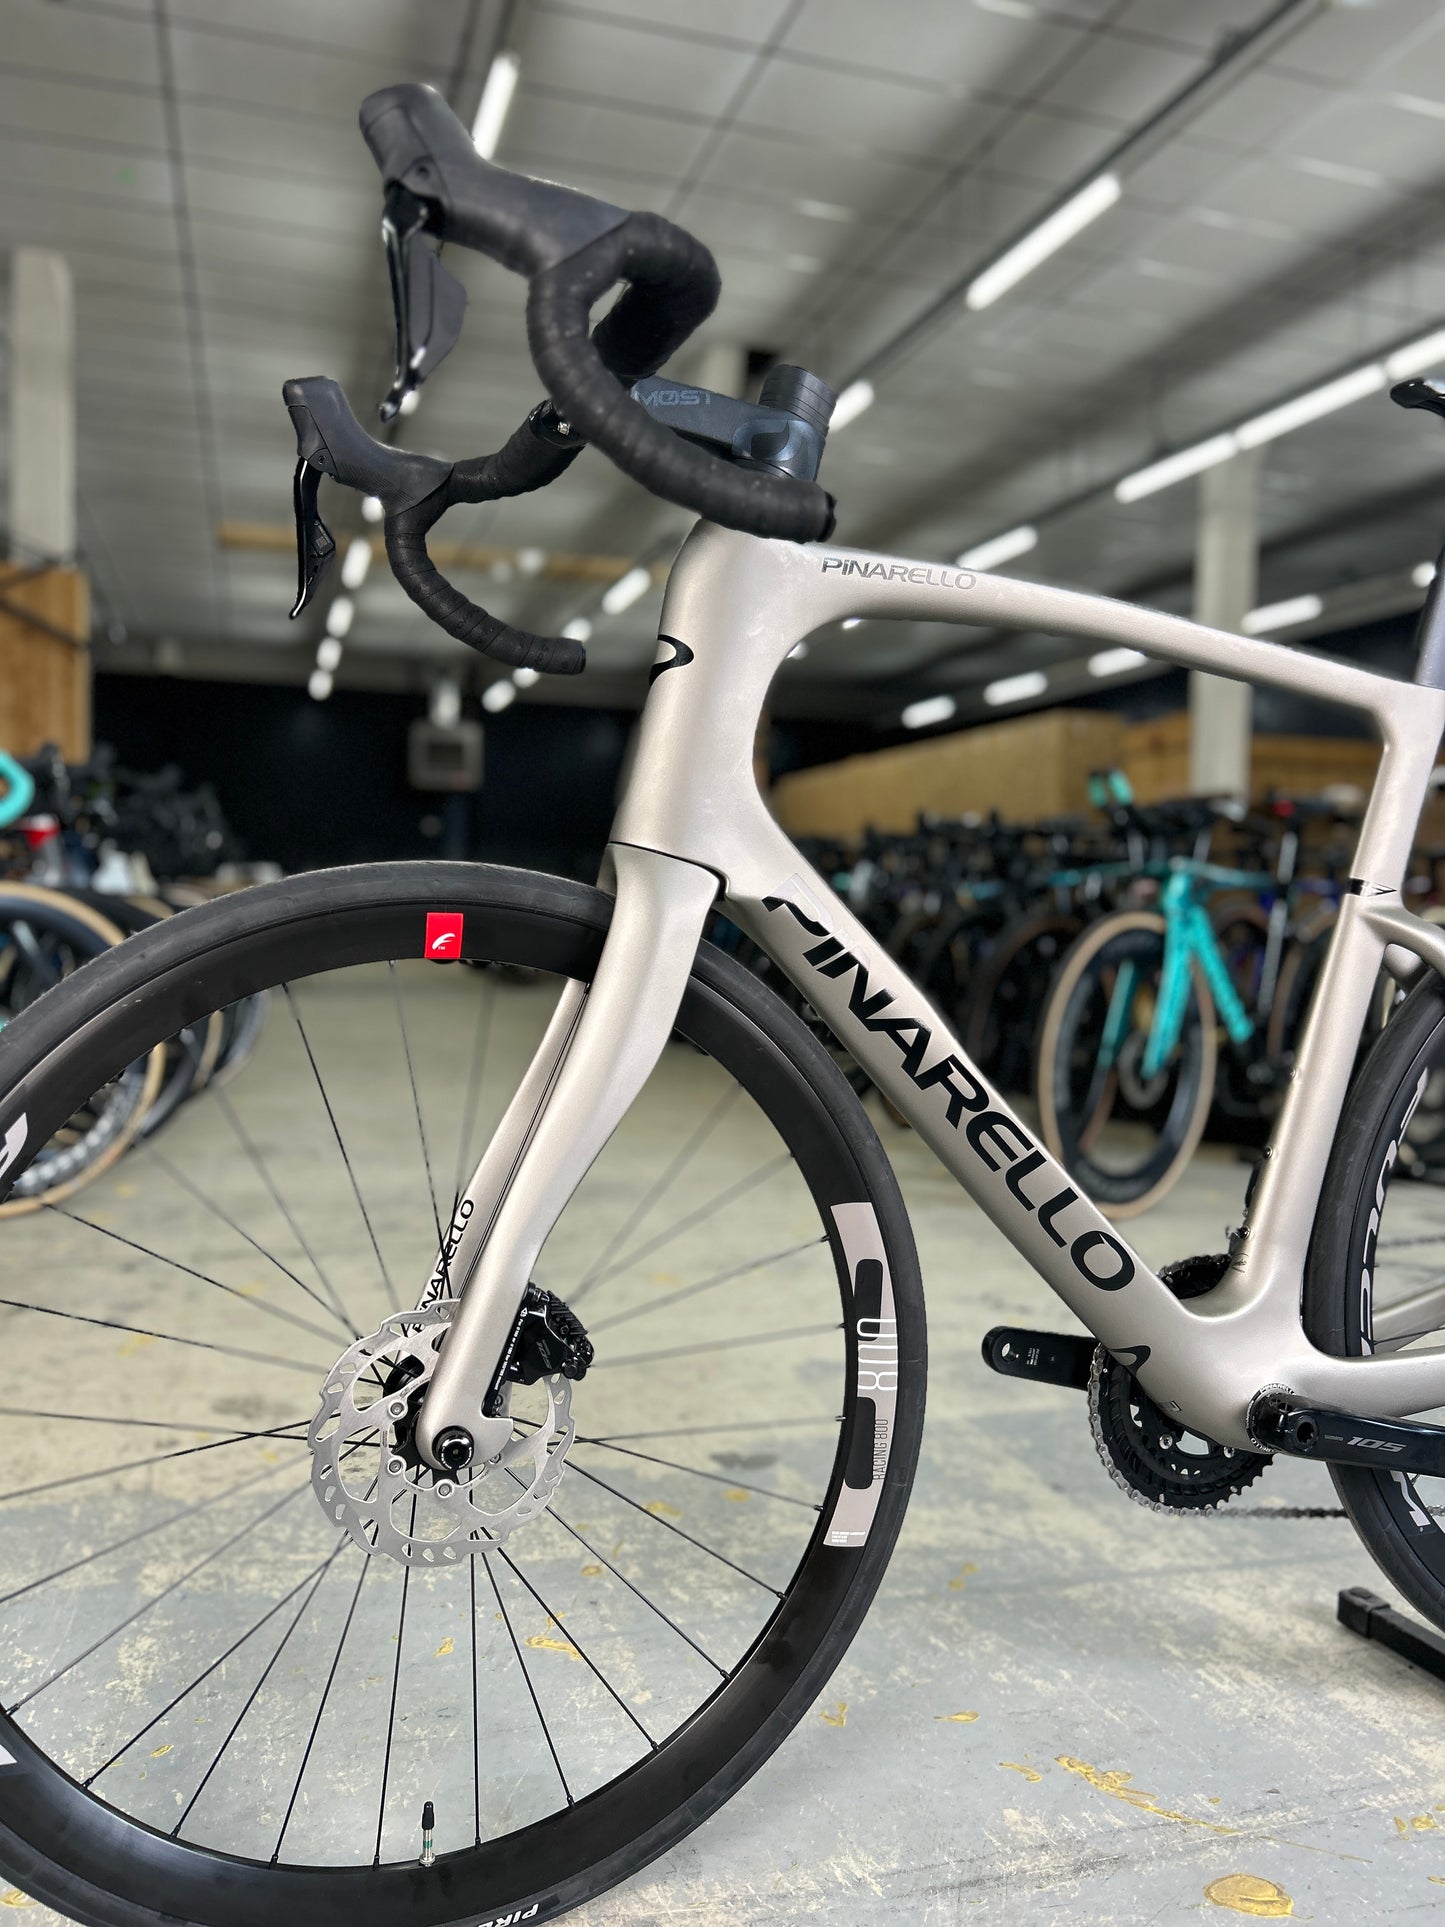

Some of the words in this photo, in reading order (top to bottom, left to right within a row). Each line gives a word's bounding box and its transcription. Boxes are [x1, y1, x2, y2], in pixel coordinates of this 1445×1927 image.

[874, 1418, 889, 1440] 800
[1347, 1436, 1406, 1453] 105
[872, 1442, 887, 1481] RACING
